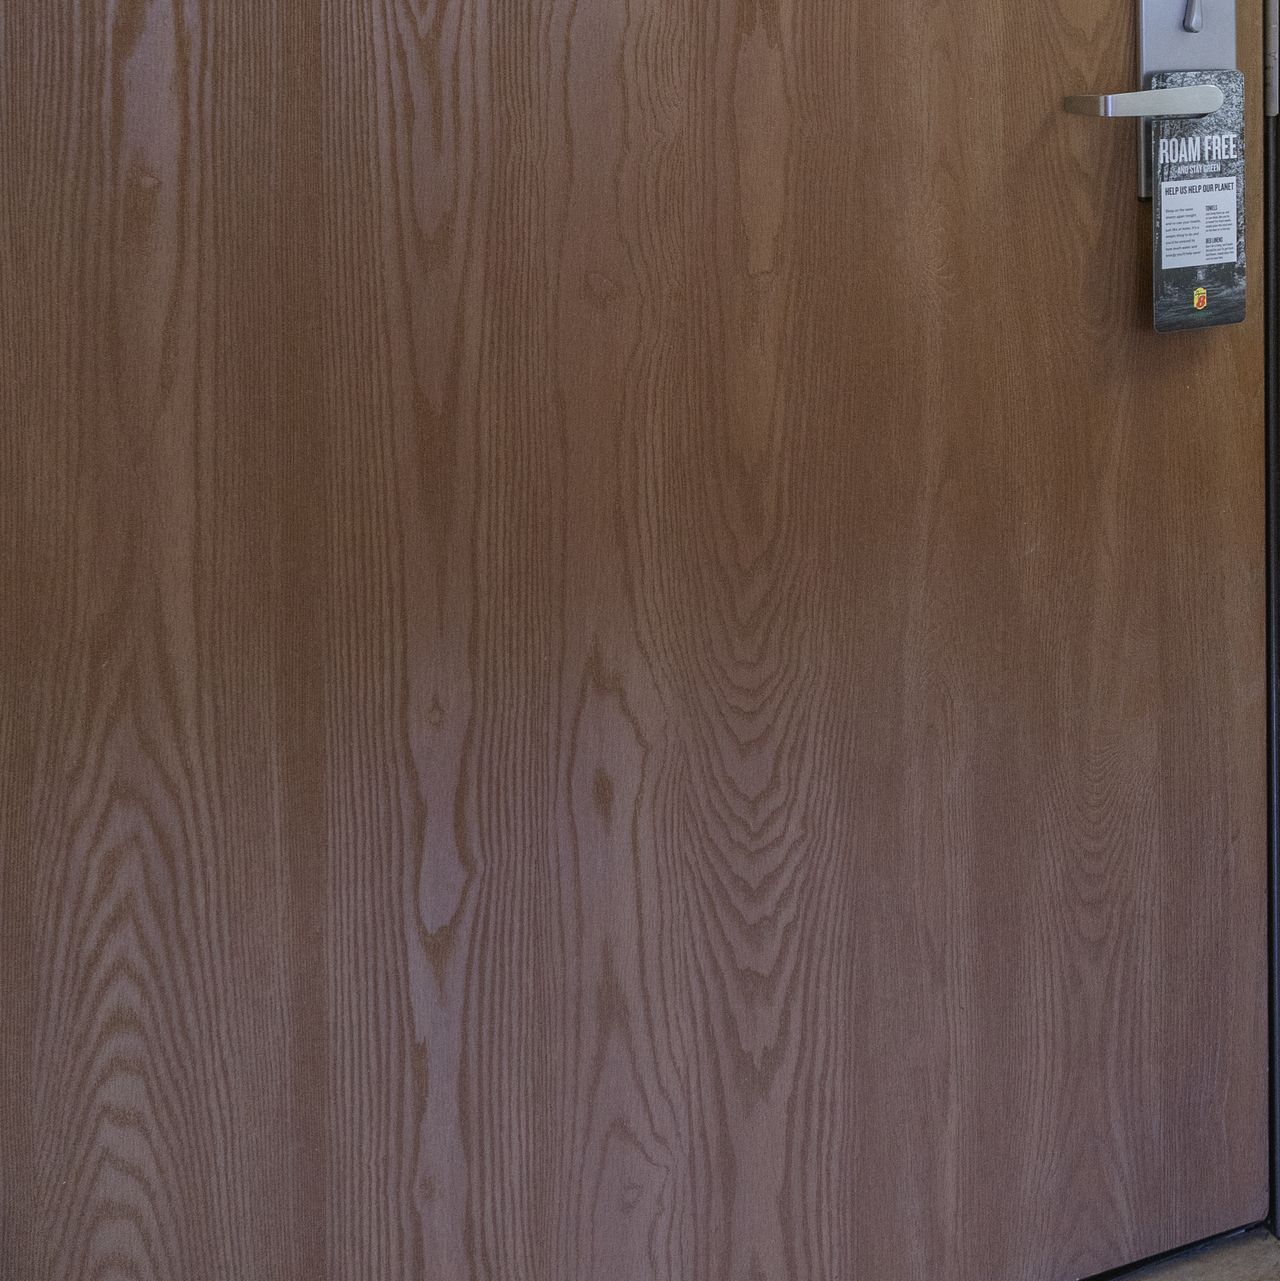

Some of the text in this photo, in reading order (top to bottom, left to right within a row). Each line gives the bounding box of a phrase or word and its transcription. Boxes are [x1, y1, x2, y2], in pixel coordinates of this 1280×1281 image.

[1160, 134, 1237, 164] ROAM FREE
[1178, 164, 1220, 174] AND STAY GREEN
[1165, 182, 1234, 196] HELP US HELP OUR PLANET
[1196, 295, 1205, 308] 8
